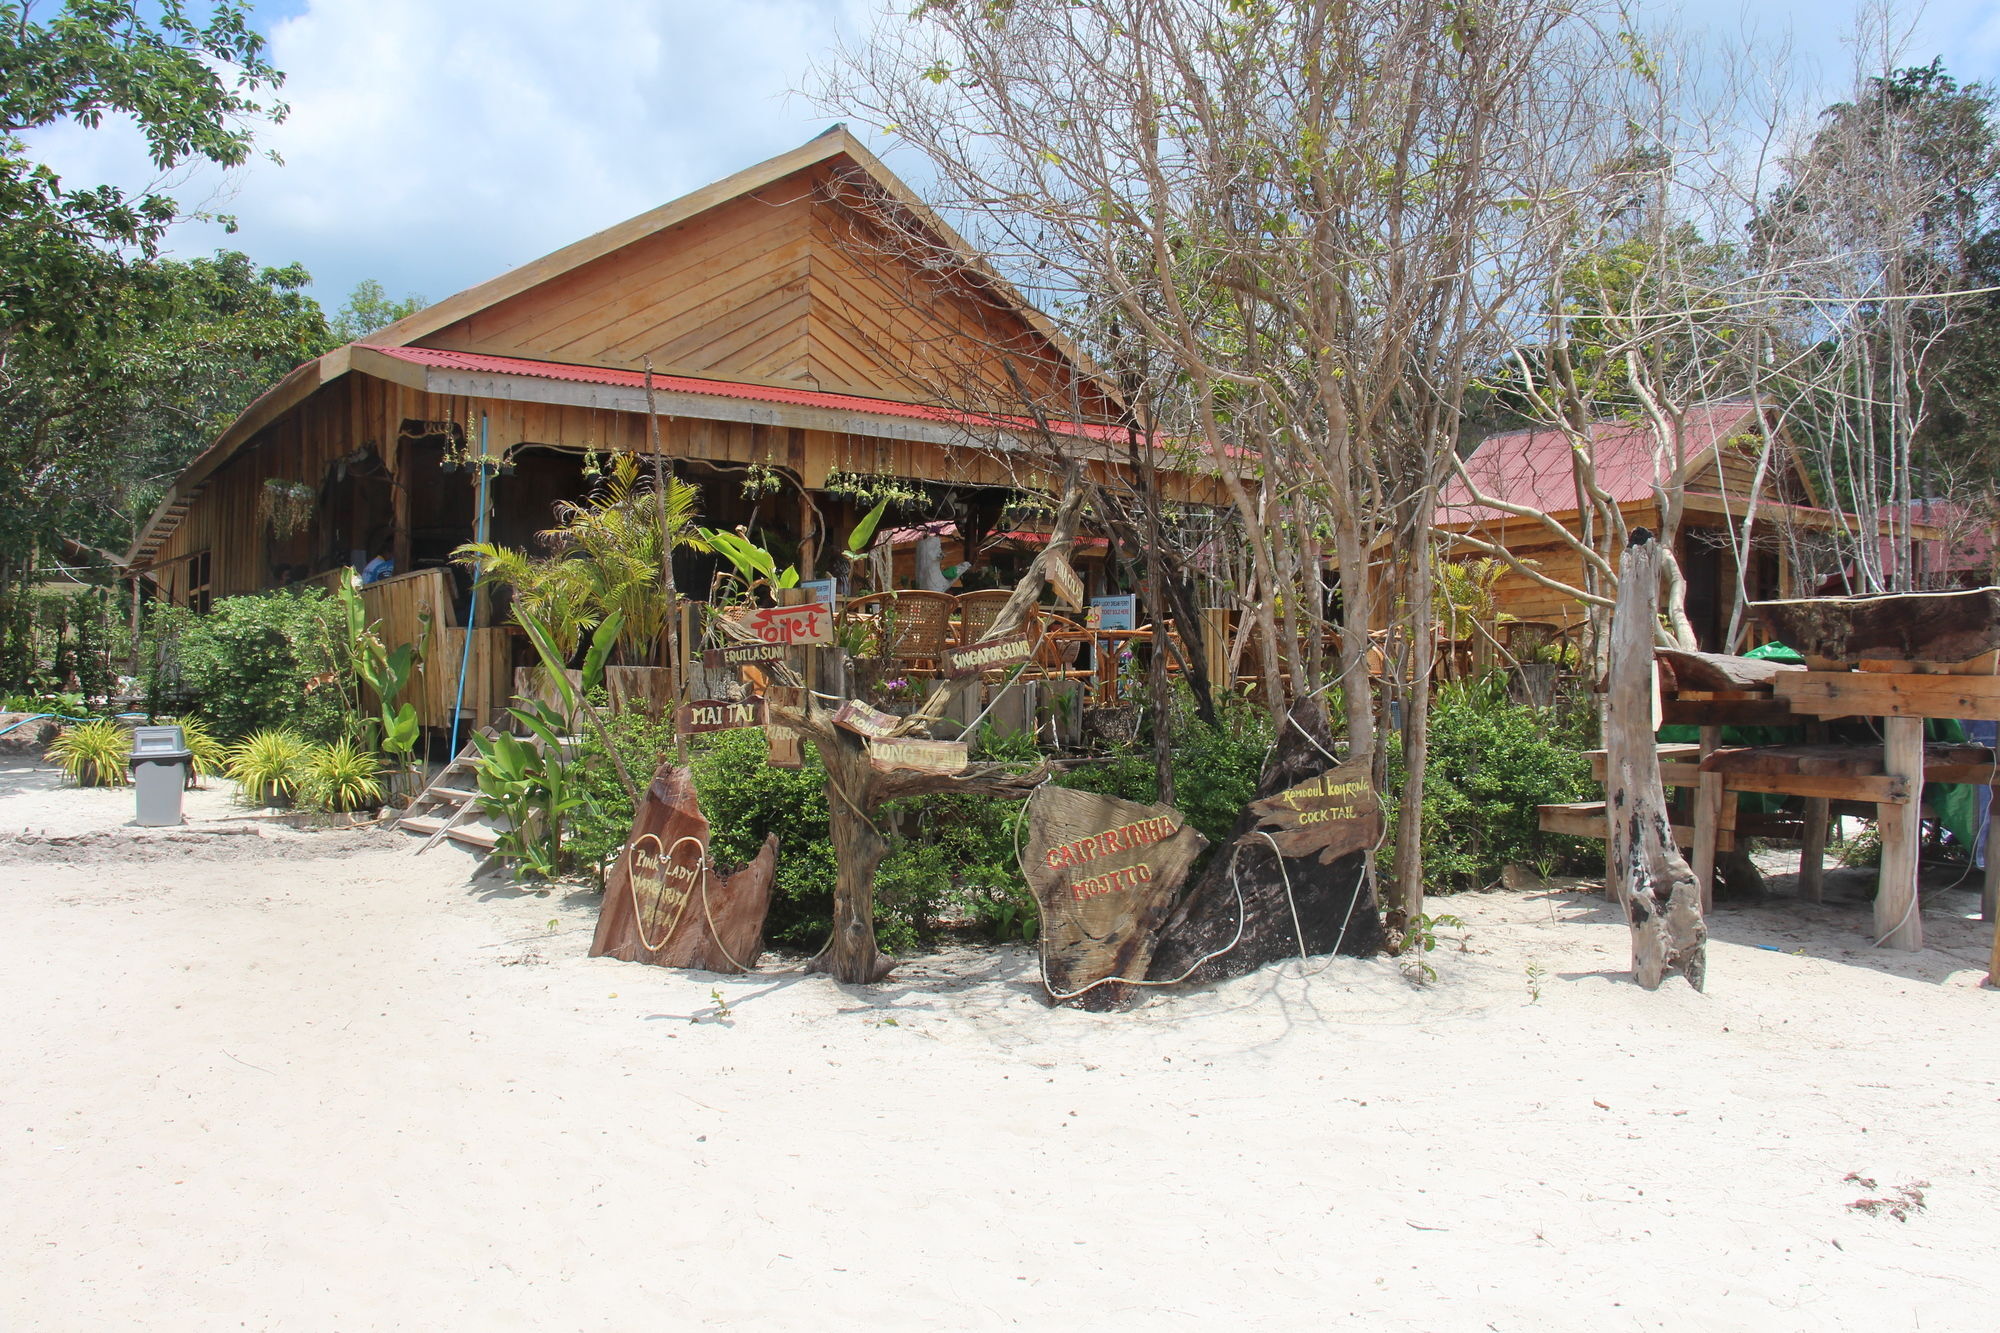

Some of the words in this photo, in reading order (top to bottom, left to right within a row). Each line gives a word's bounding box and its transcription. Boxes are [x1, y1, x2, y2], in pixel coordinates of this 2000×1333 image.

[751, 612, 821, 645] Toilet
[691, 707, 723, 725] MAI
[727, 703, 755, 723] TAI
[872, 743, 916, 765] LONG
[1046, 815, 1178, 871] CAIPIRINHA
[665, 859, 694, 883] LADY
[1071, 862, 1152, 902] MOJITO
